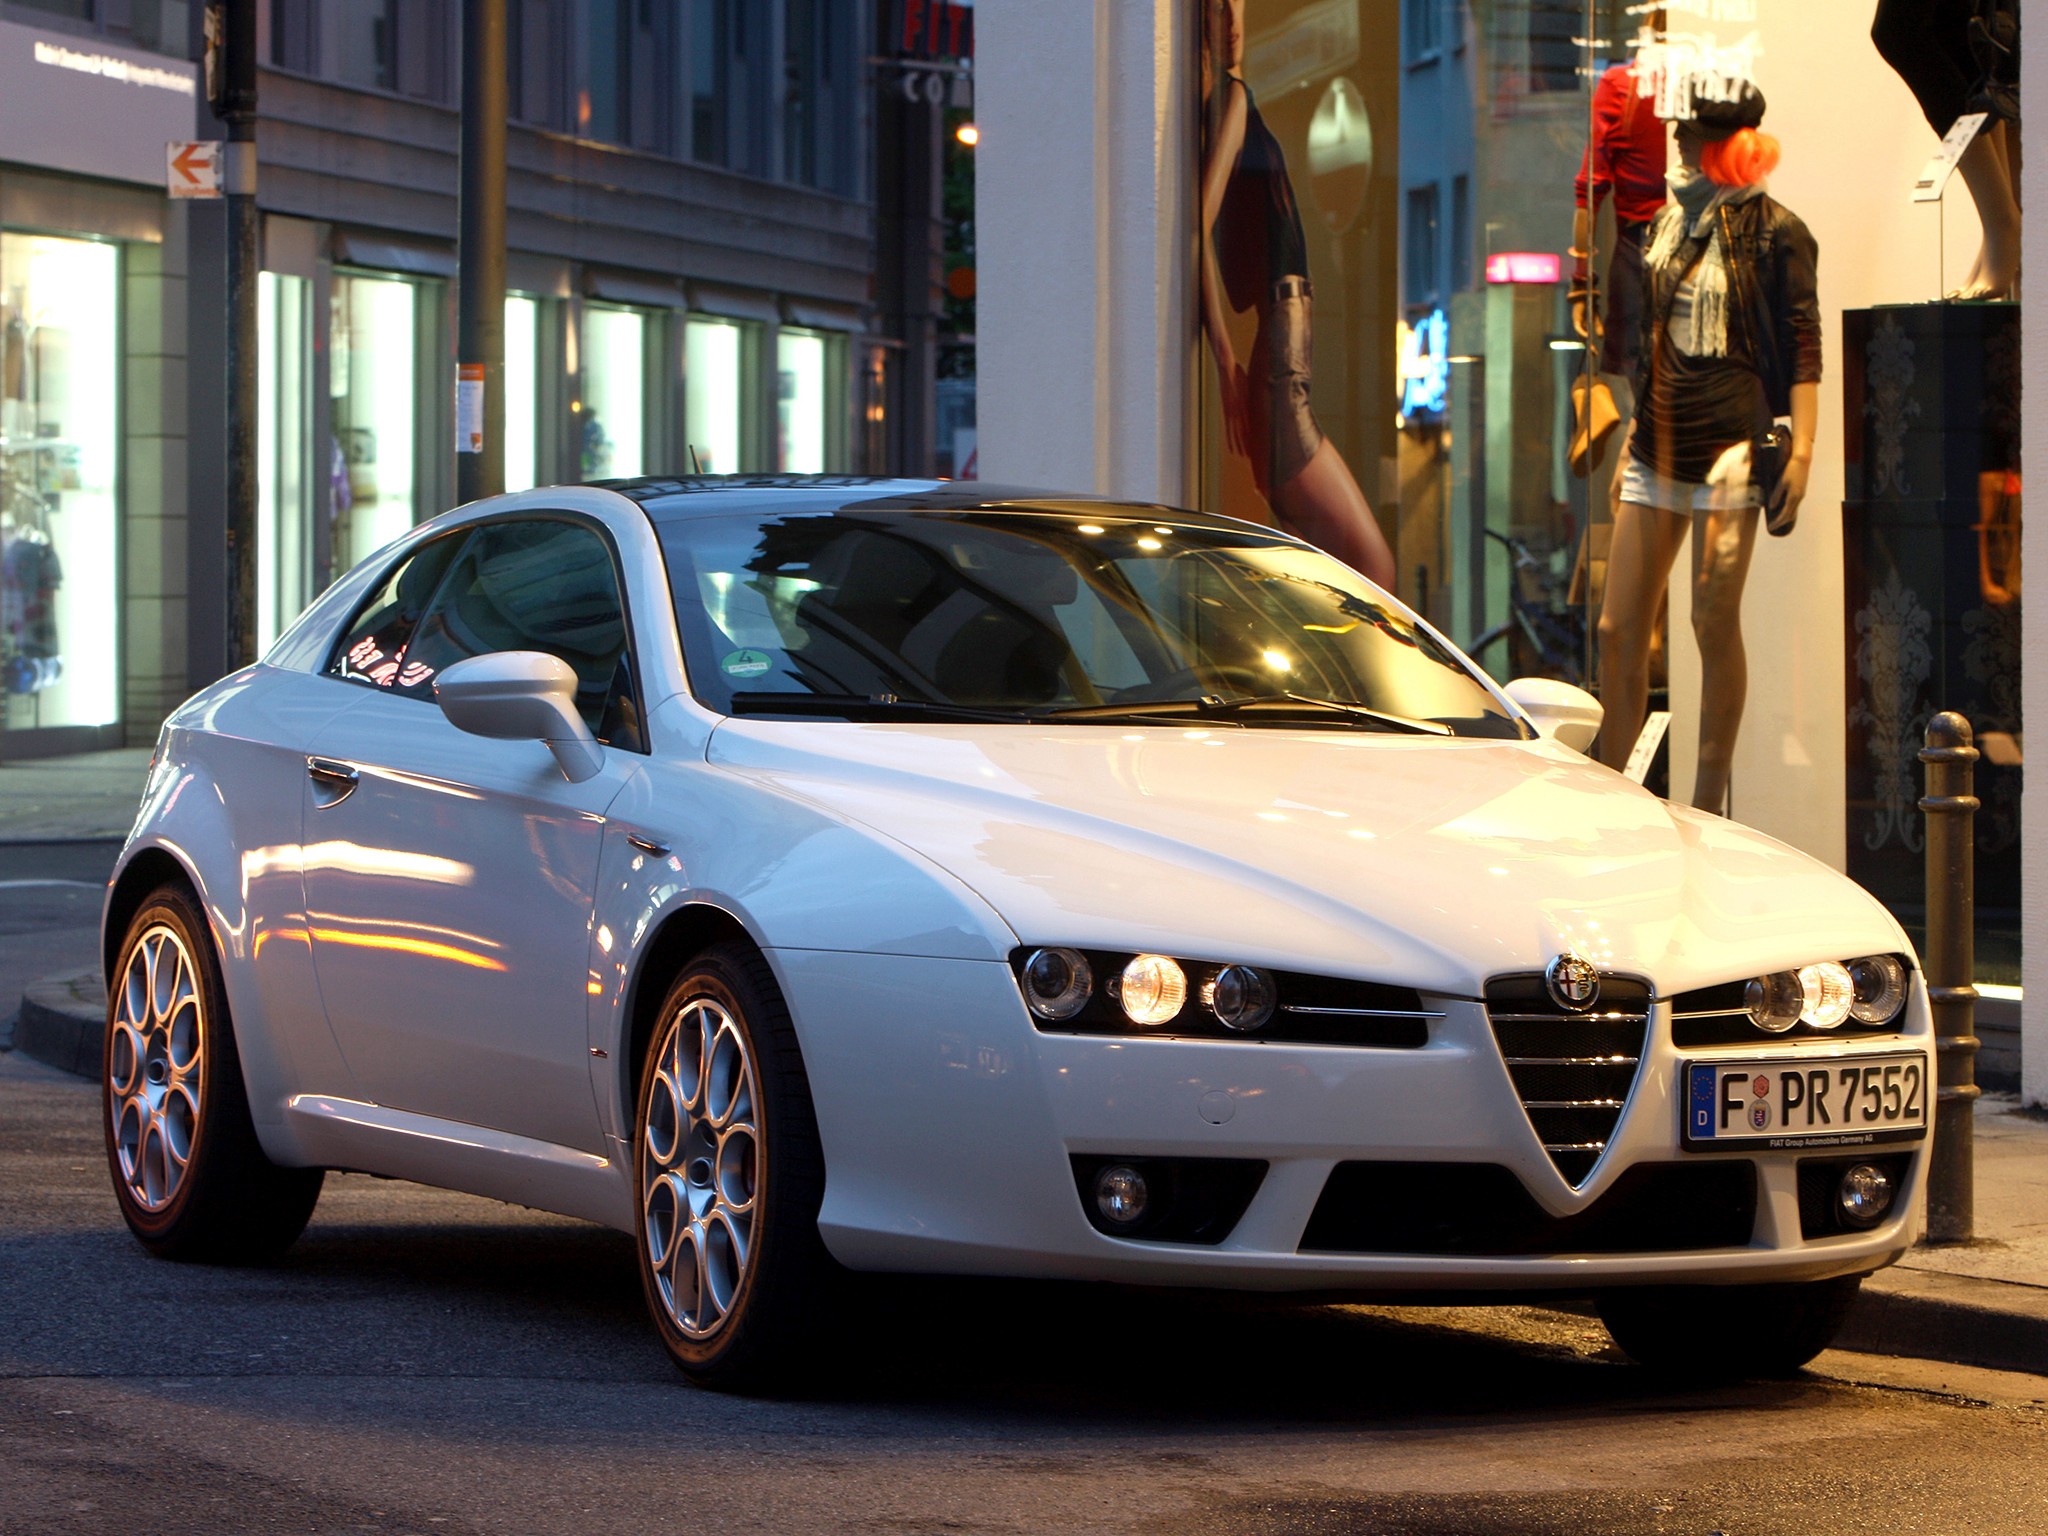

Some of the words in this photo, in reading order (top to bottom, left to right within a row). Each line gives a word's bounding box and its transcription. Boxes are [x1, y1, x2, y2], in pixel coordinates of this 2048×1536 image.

[903, 0, 974, 56] FIT
[738, 650, 753, 663] 4
[1721, 1073, 1748, 1129] F
[1780, 1070, 1831, 1126] PR
[1840, 1065, 1920, 1122] 7552
[1698, 1110, 1708, 1126] D
[1769, 1138, 1784, 1148] FIAT
[1784, 1138, 1804, 1148] Group
[1805, 1137, 1840, 1146] Automobiles
[1840, 1135, 1864, 1144] Germany
[1865, 1134, 1873, 1142] AG
